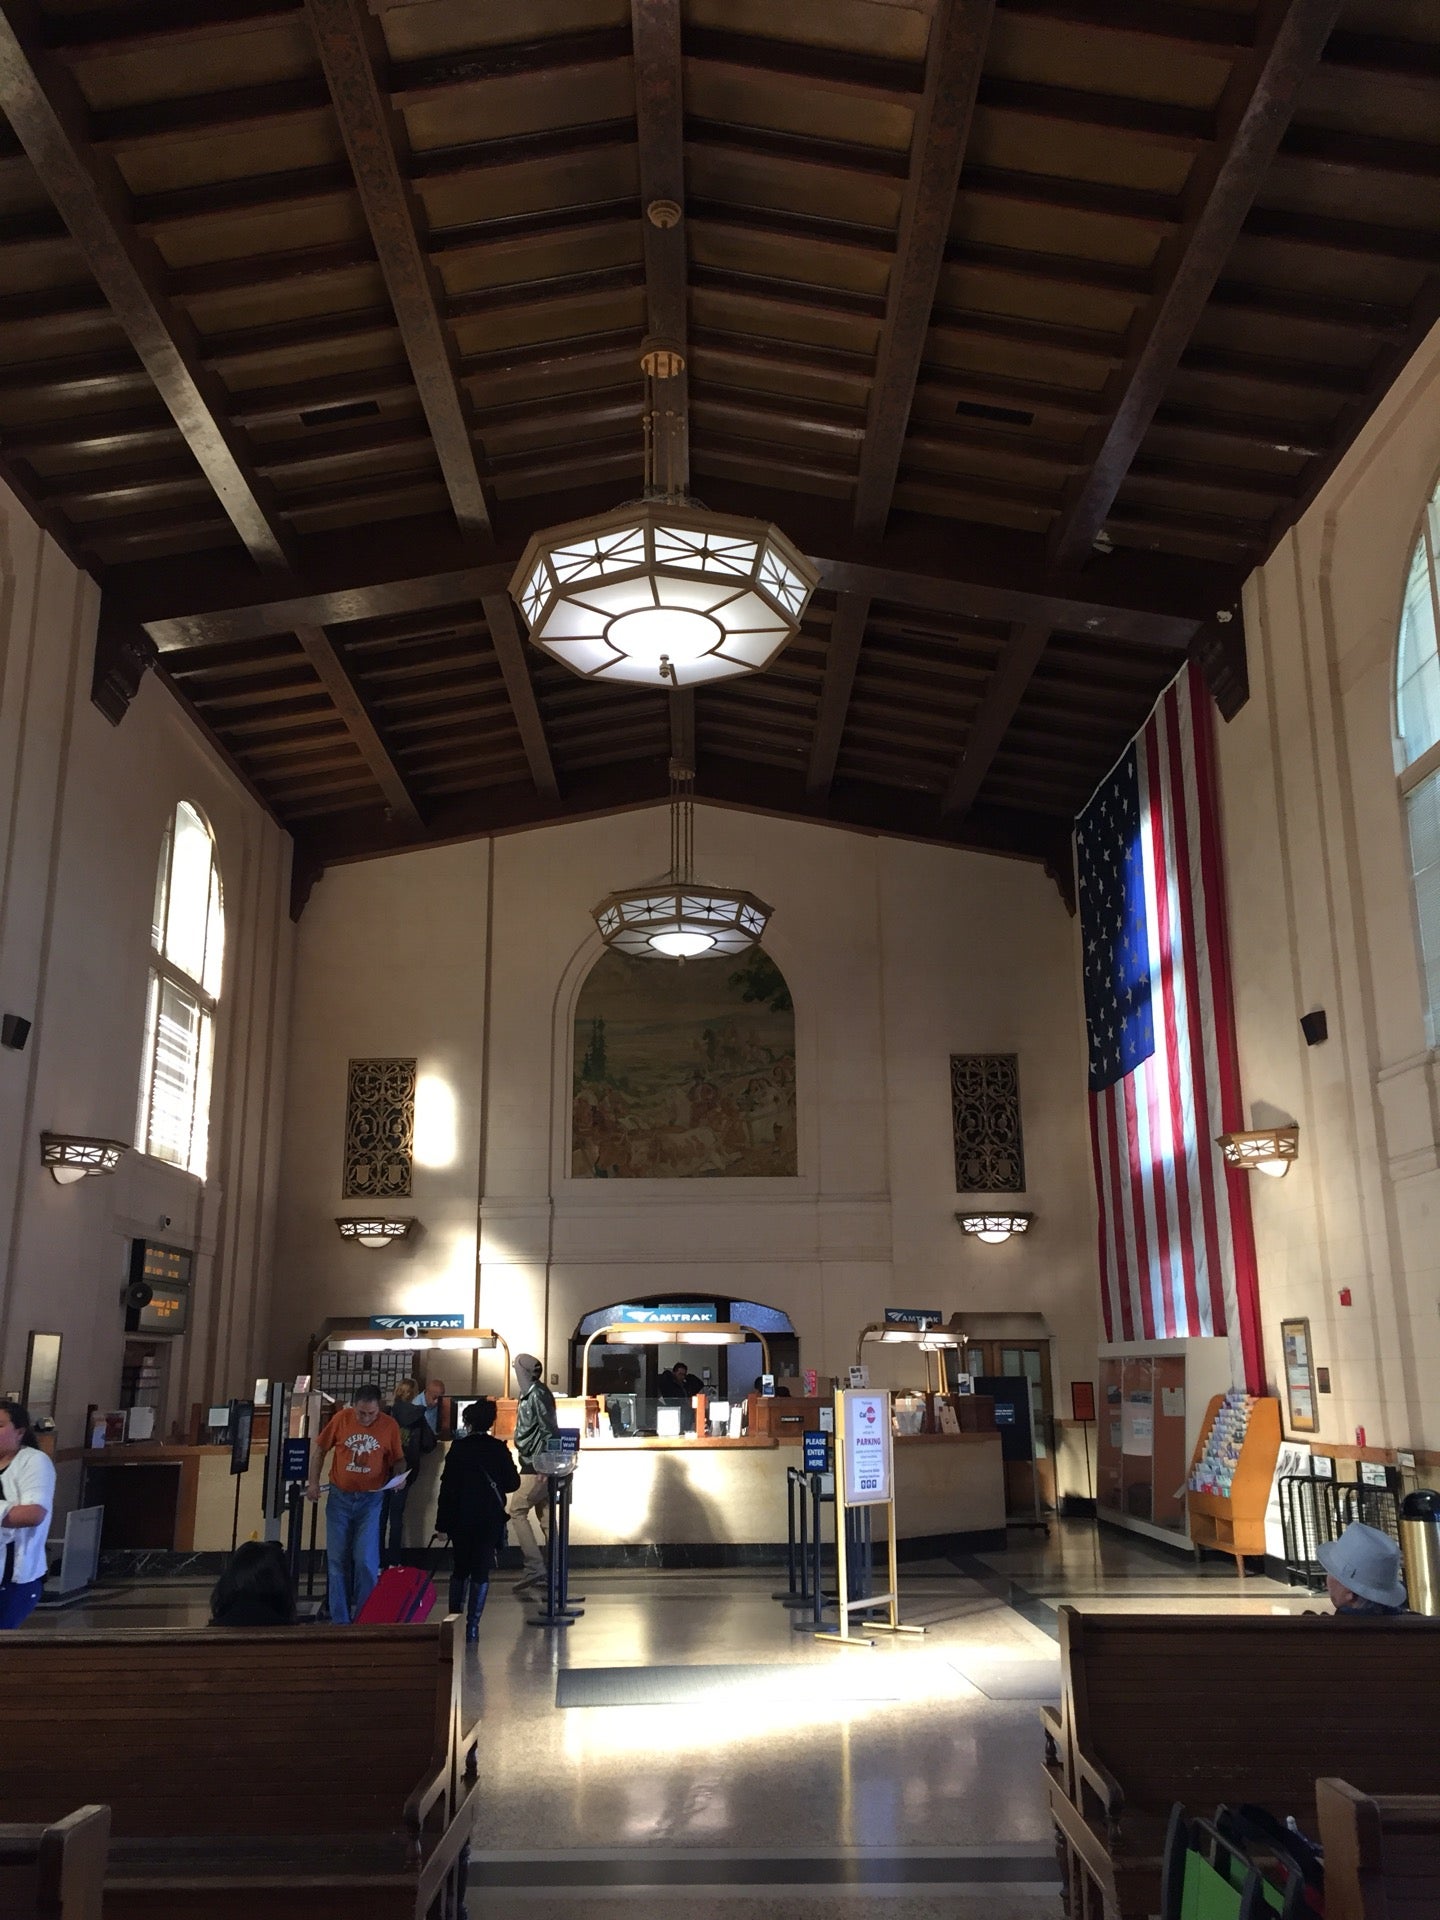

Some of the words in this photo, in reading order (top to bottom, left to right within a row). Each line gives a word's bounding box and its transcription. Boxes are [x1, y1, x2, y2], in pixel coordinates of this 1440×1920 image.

[649, 1313, 710, 1322] AMTRAK
[901, 1315, 938, 1323] AMTAK
[344, 1433, 362, 1448] BEER
[362, 1433, 381, 1451] PONG
[805, 1438, 827, 1446] PLEASE
[856, 1438, 881, 1447] PARKING
